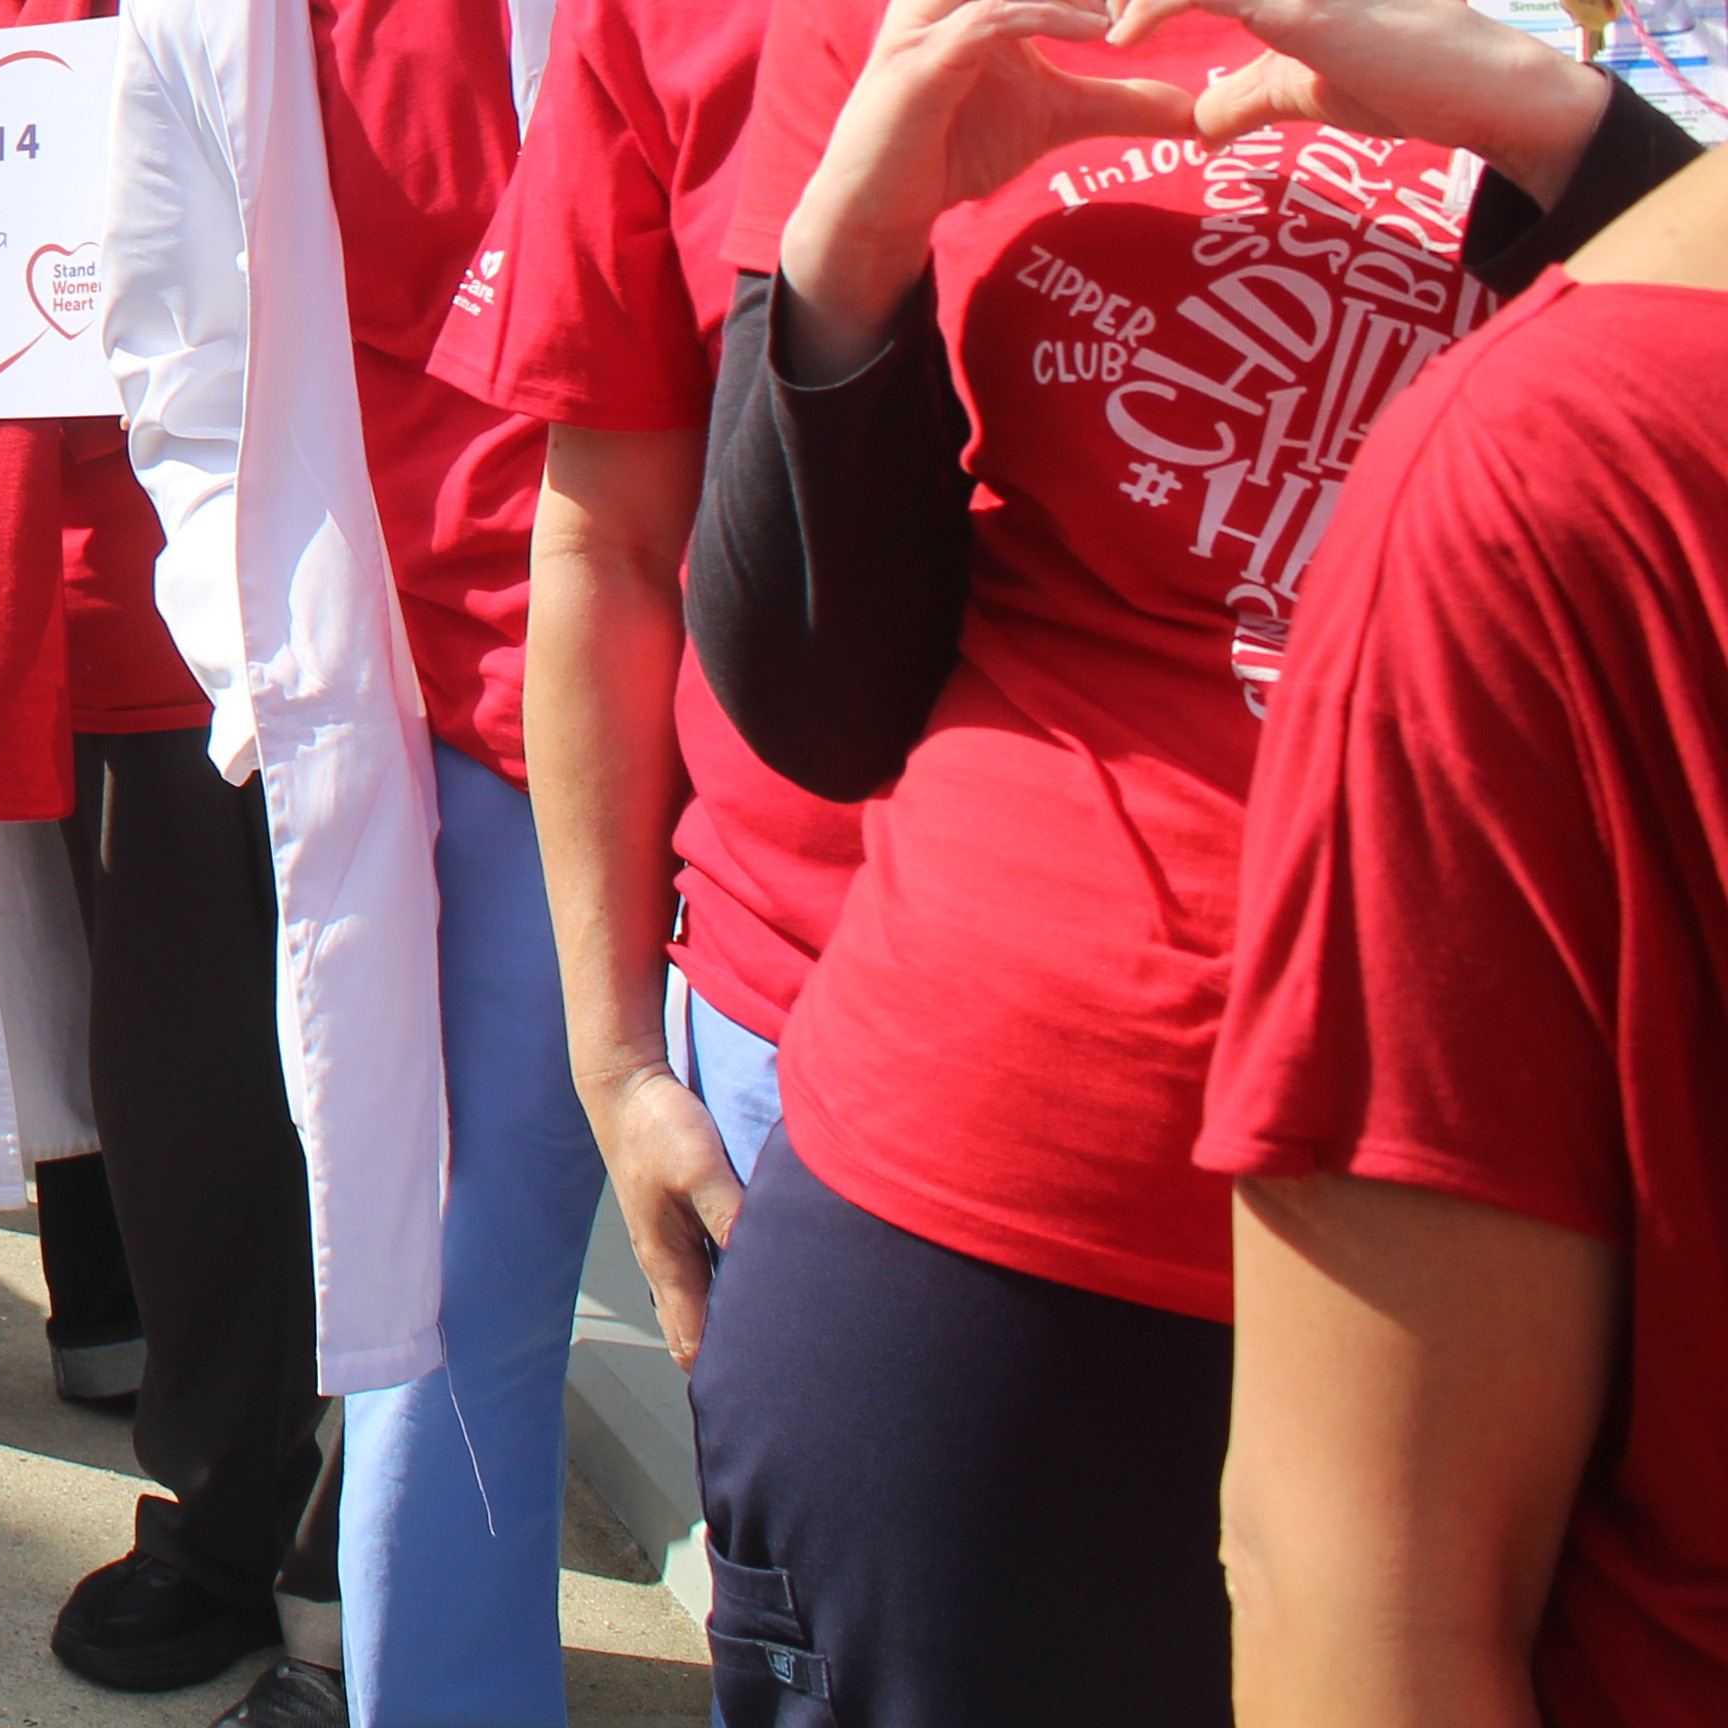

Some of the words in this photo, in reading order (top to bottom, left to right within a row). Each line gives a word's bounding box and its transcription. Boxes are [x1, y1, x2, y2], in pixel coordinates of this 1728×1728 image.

[16, 123, 40, 160] 4
[1276, 123, 1407, 275] STRE
[53, 262, 96, 279] Stand
[53, 297, 95, 313] Heart
[1016, 245, 1157, 348] ZIPPER
[1032, 336, 1130, 386] CLUB
[1105, 264, 1332, 467] CHD
